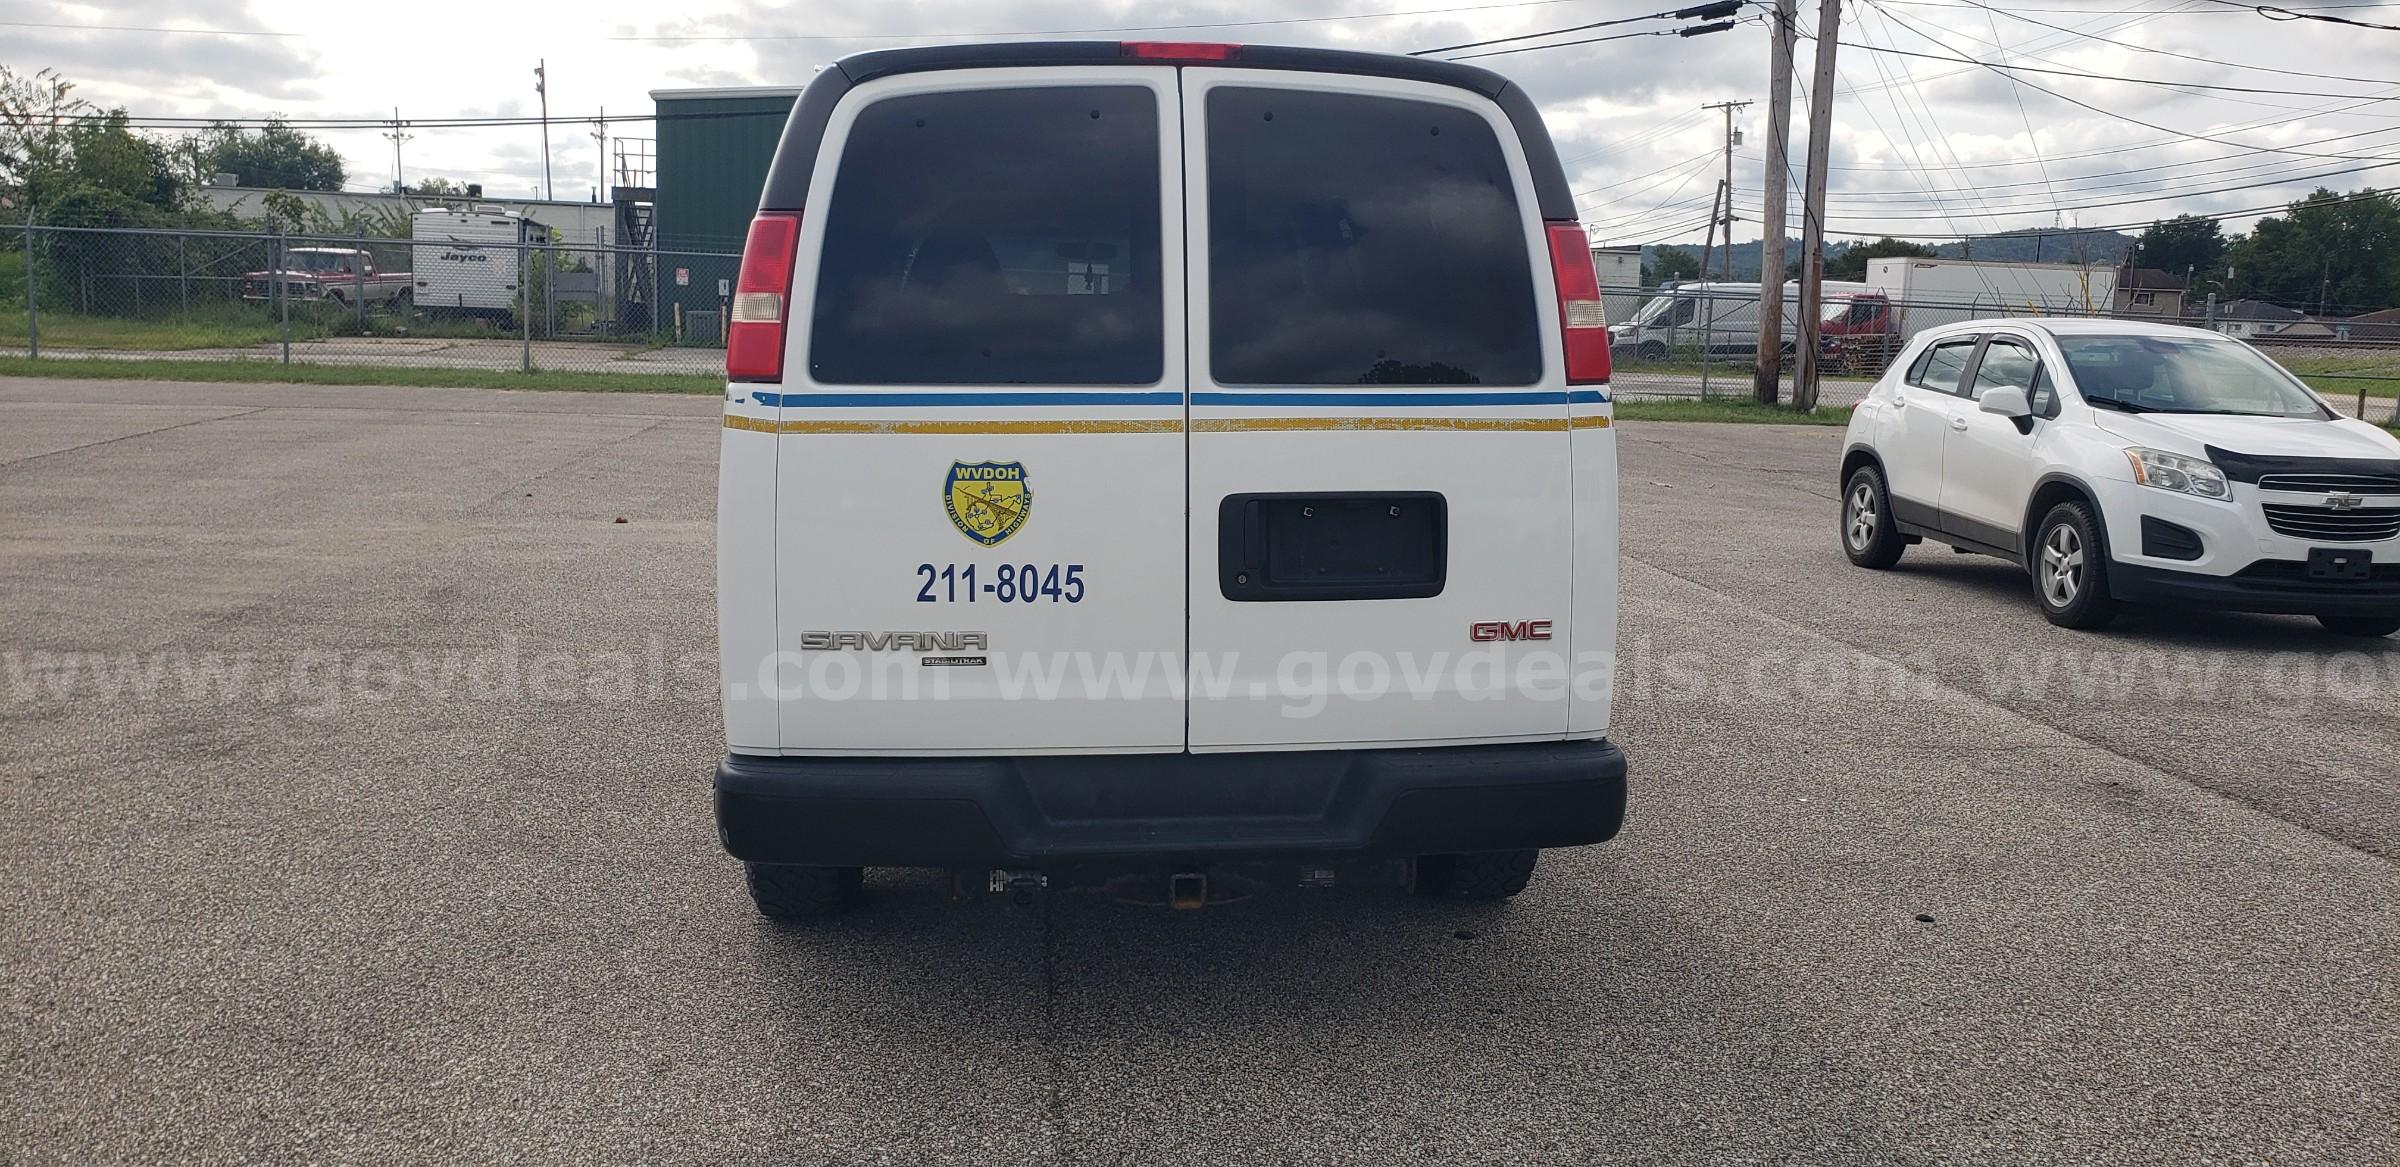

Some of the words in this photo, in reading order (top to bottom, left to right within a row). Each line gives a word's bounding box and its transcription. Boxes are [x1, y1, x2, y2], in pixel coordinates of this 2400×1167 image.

[441, 252, 487, 262] Jayco
[955, 467, 1020, 480] WVDOH
[945, 494, 969, 532] DIVISION
[1005, 493, 1031, 535] HIGHWAYS
[916, 563, 1085, 603] 211-8045
[1470, 619, 1552, 641] GMC
[800, 631, 987, 651] SAVANA
